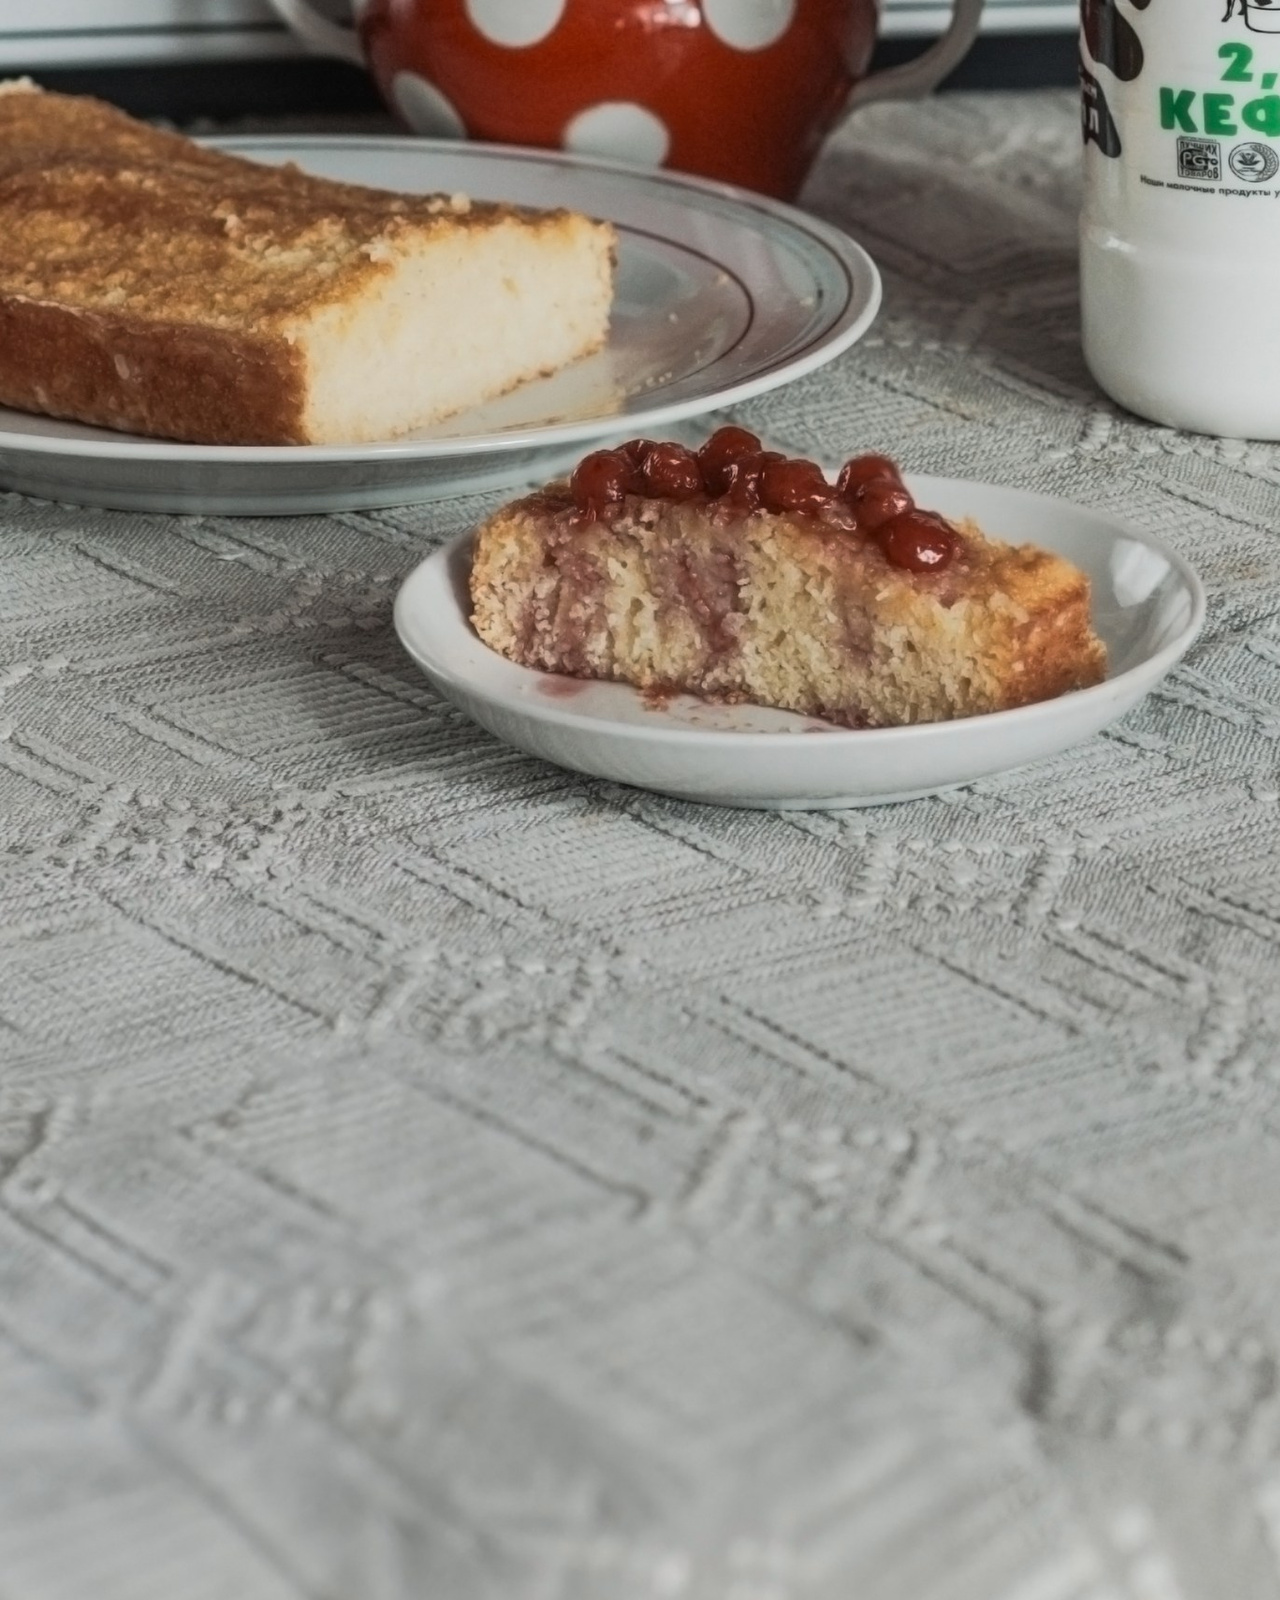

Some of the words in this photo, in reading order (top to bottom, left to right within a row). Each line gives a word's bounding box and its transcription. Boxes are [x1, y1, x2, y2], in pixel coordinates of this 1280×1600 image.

[1140, 174, 1164, 187] Наши
[1166, 181, 1215, 194] молочные
[1219, 187, 1271, 198] продукты
